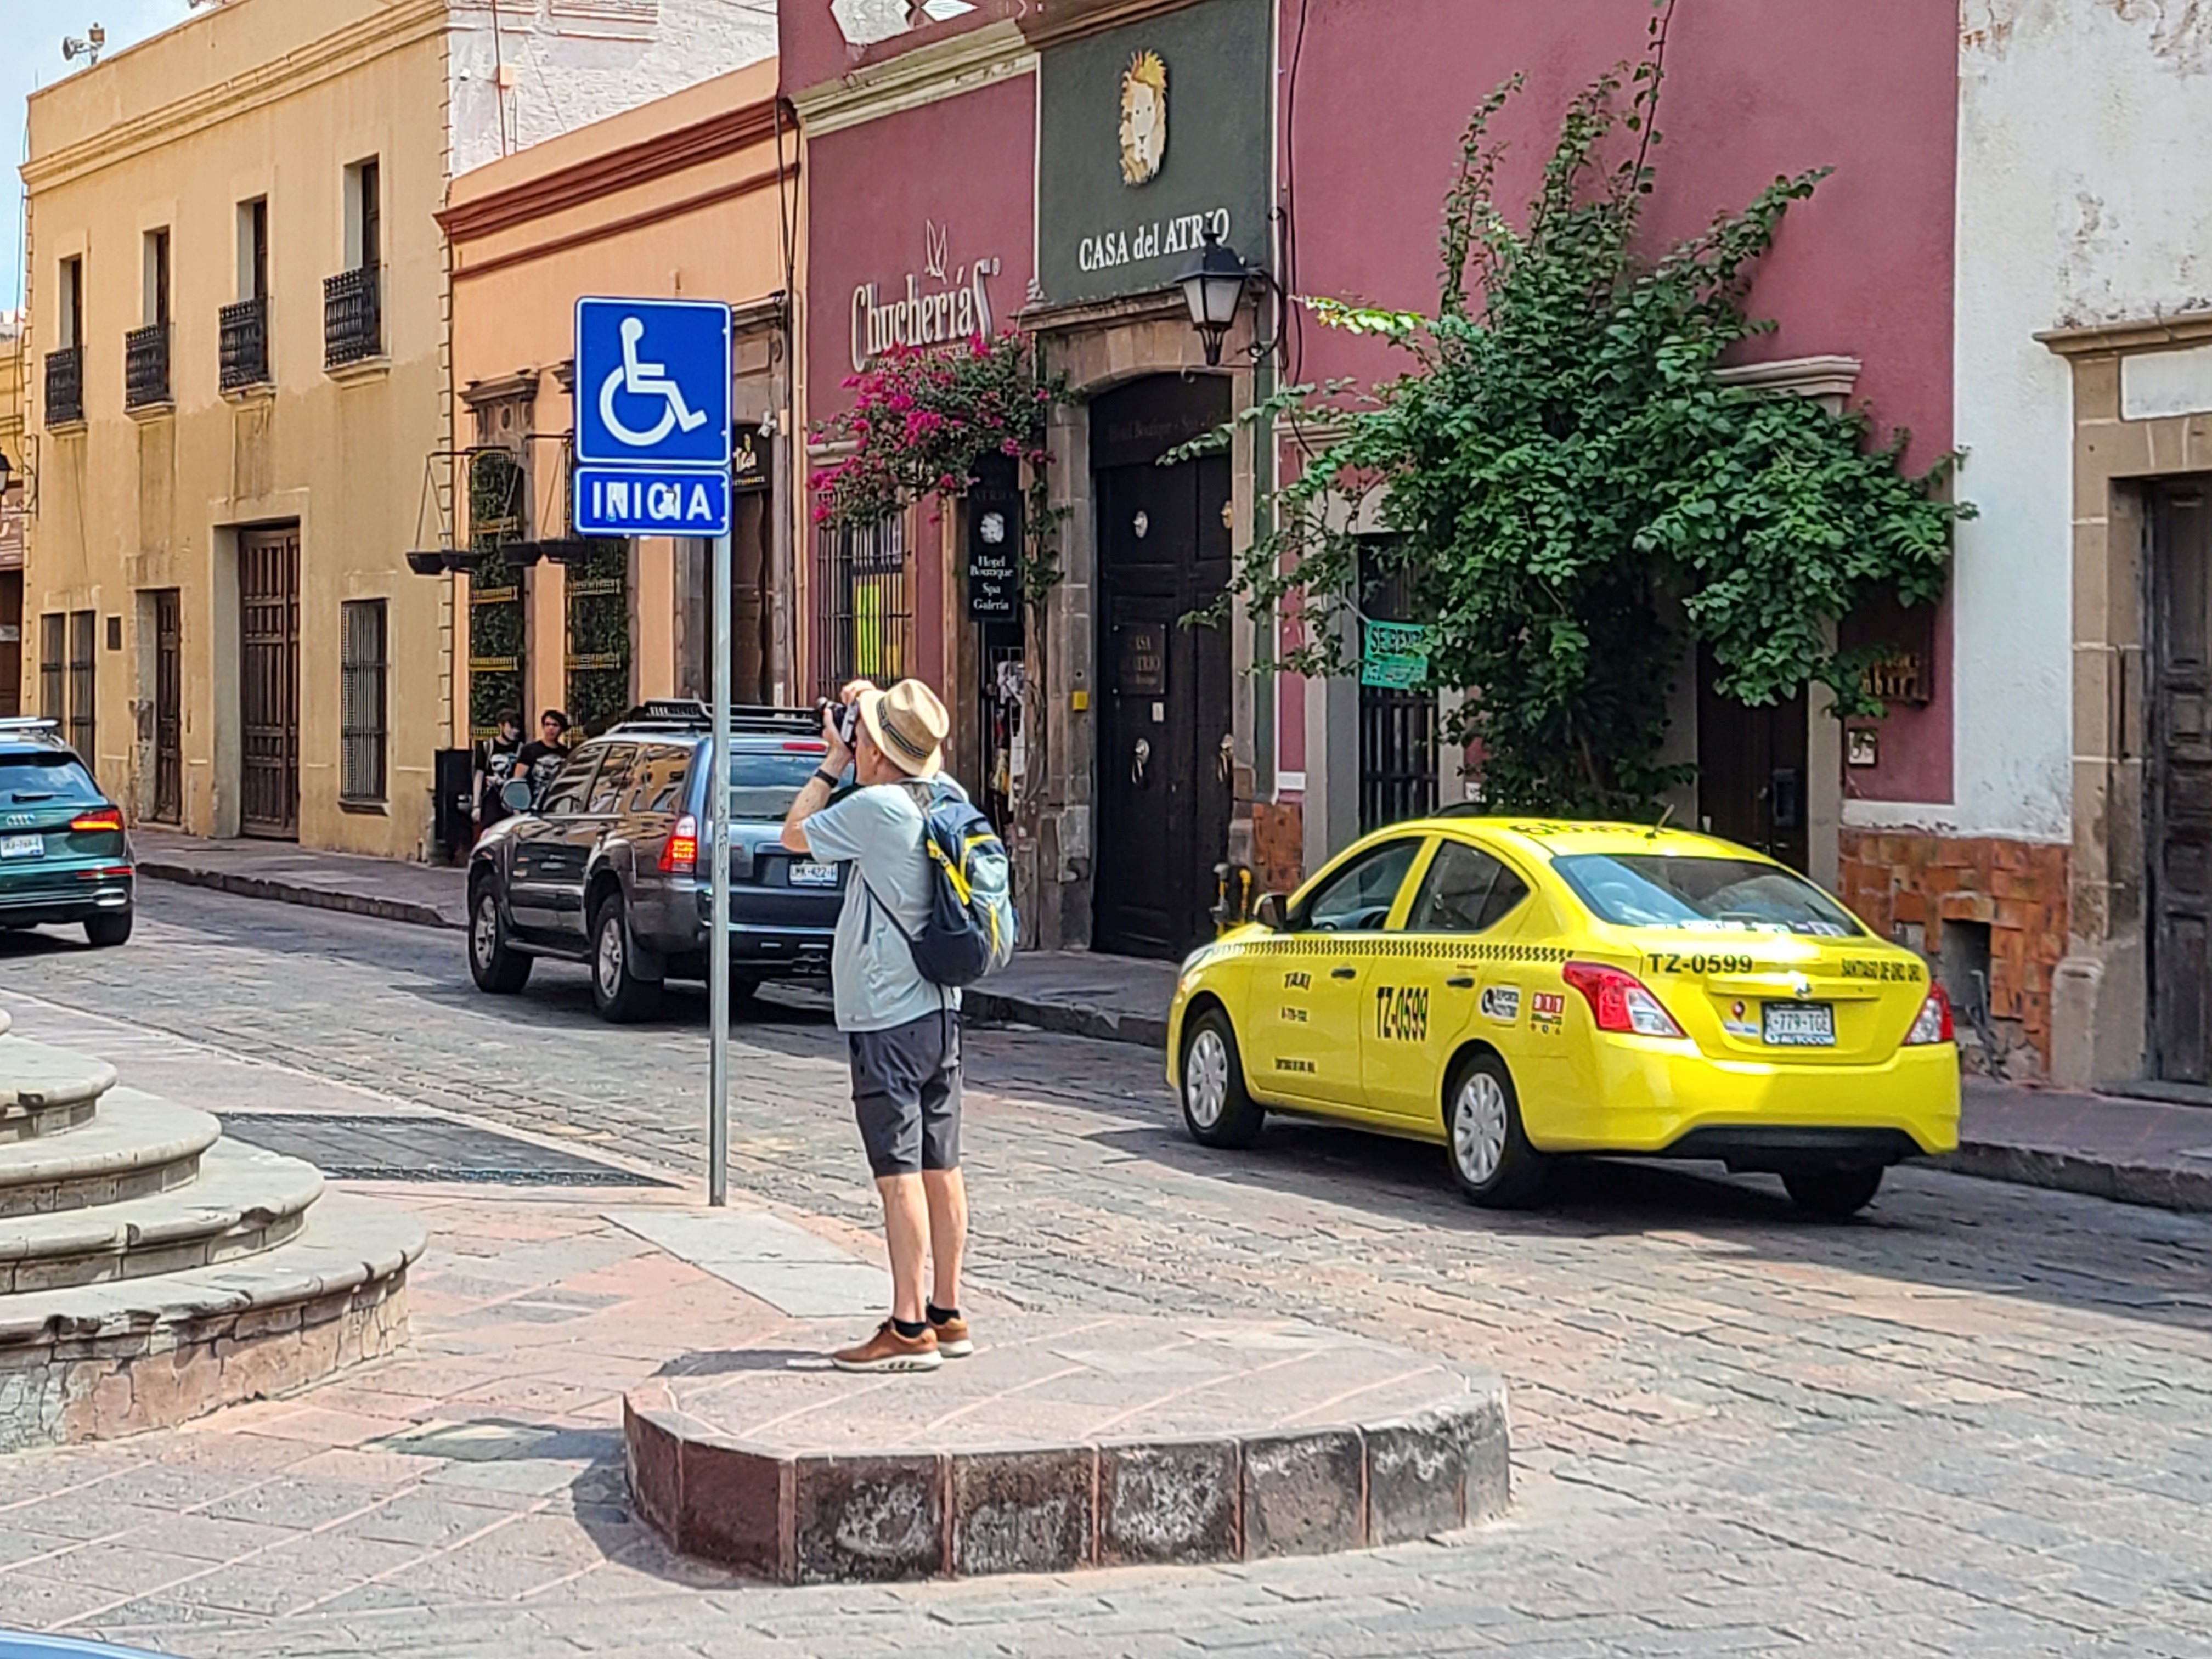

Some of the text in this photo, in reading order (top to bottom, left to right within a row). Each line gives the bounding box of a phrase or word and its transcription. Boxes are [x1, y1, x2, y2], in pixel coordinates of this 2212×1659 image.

[1079, 208, 1229, 271] CASA del ATRO
[982, 582, 1001, 596] Spa
[1647, 953, 1753, 974] TZ-0599
[1285, 972, 1311, 991] TAXI
[1376, 986, 1428, 1042] TZ-0599
